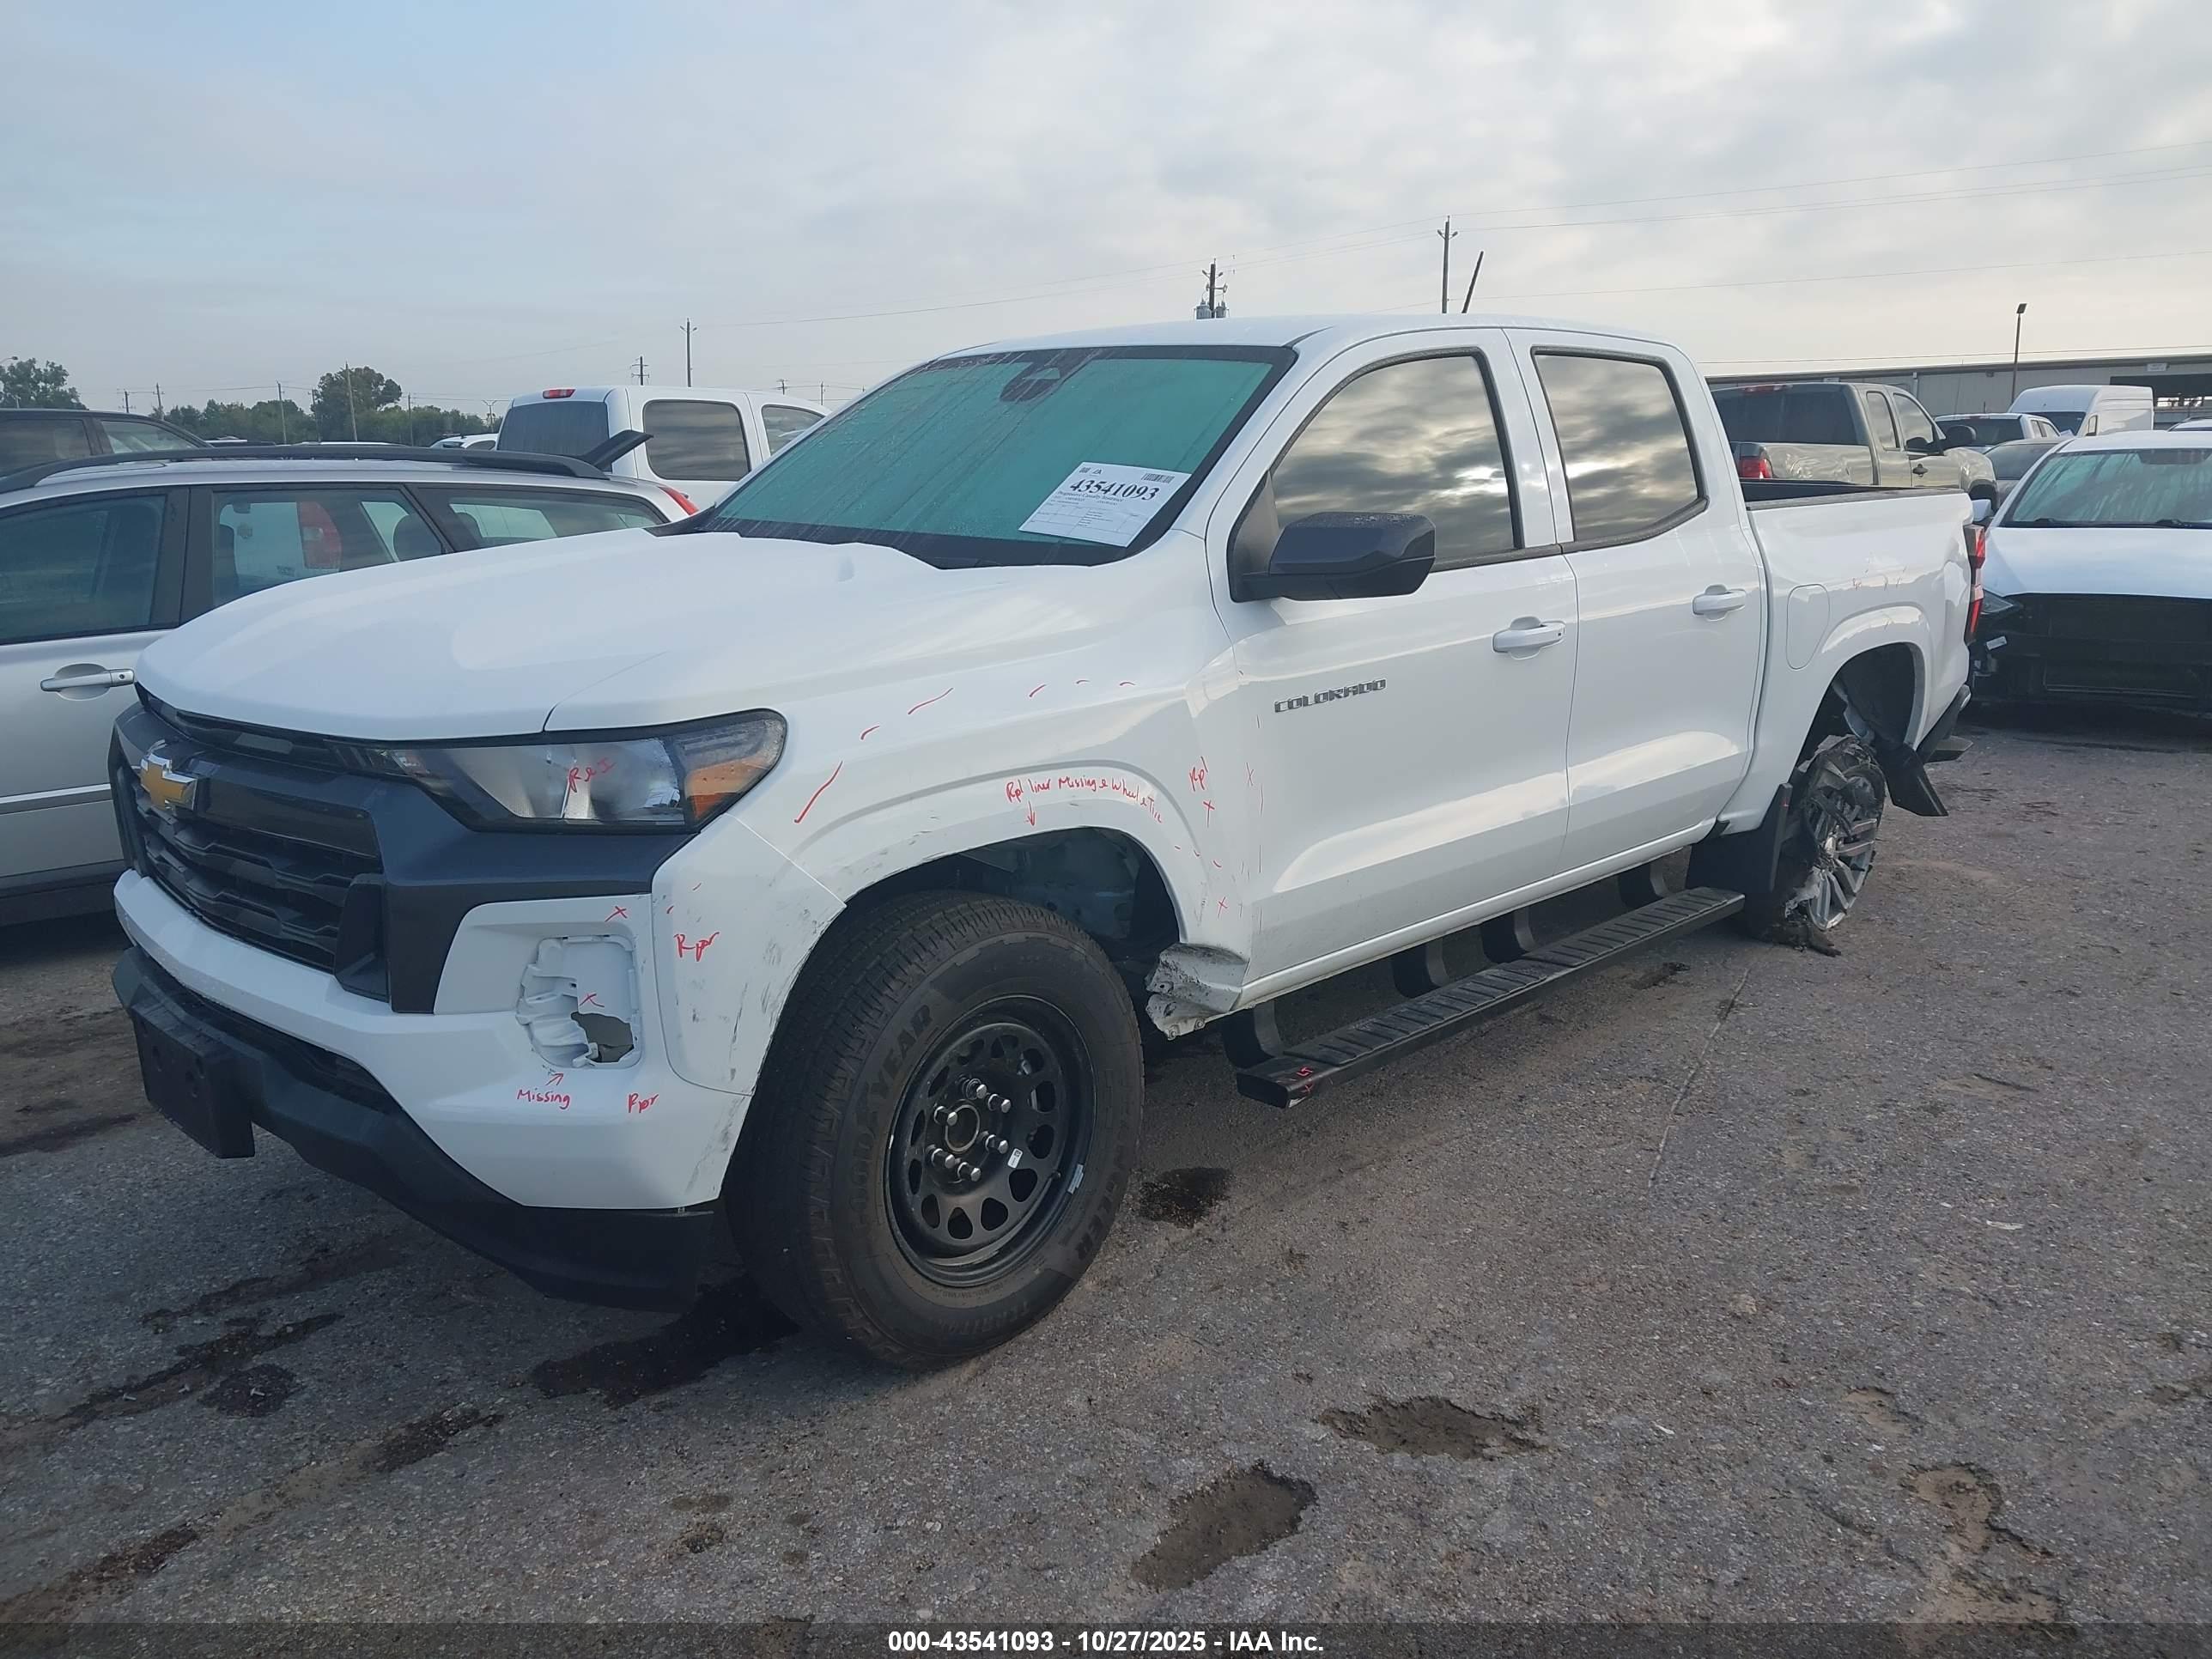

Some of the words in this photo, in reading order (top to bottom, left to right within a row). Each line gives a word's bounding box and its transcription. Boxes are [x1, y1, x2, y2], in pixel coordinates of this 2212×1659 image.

[1070, 479, 1160, 501] 43541093
[1274, 678, 1386, 713] COLORADO
[1058, 776, 1097, 793] Missing
[516, 1088, 570, 1109] Missing
